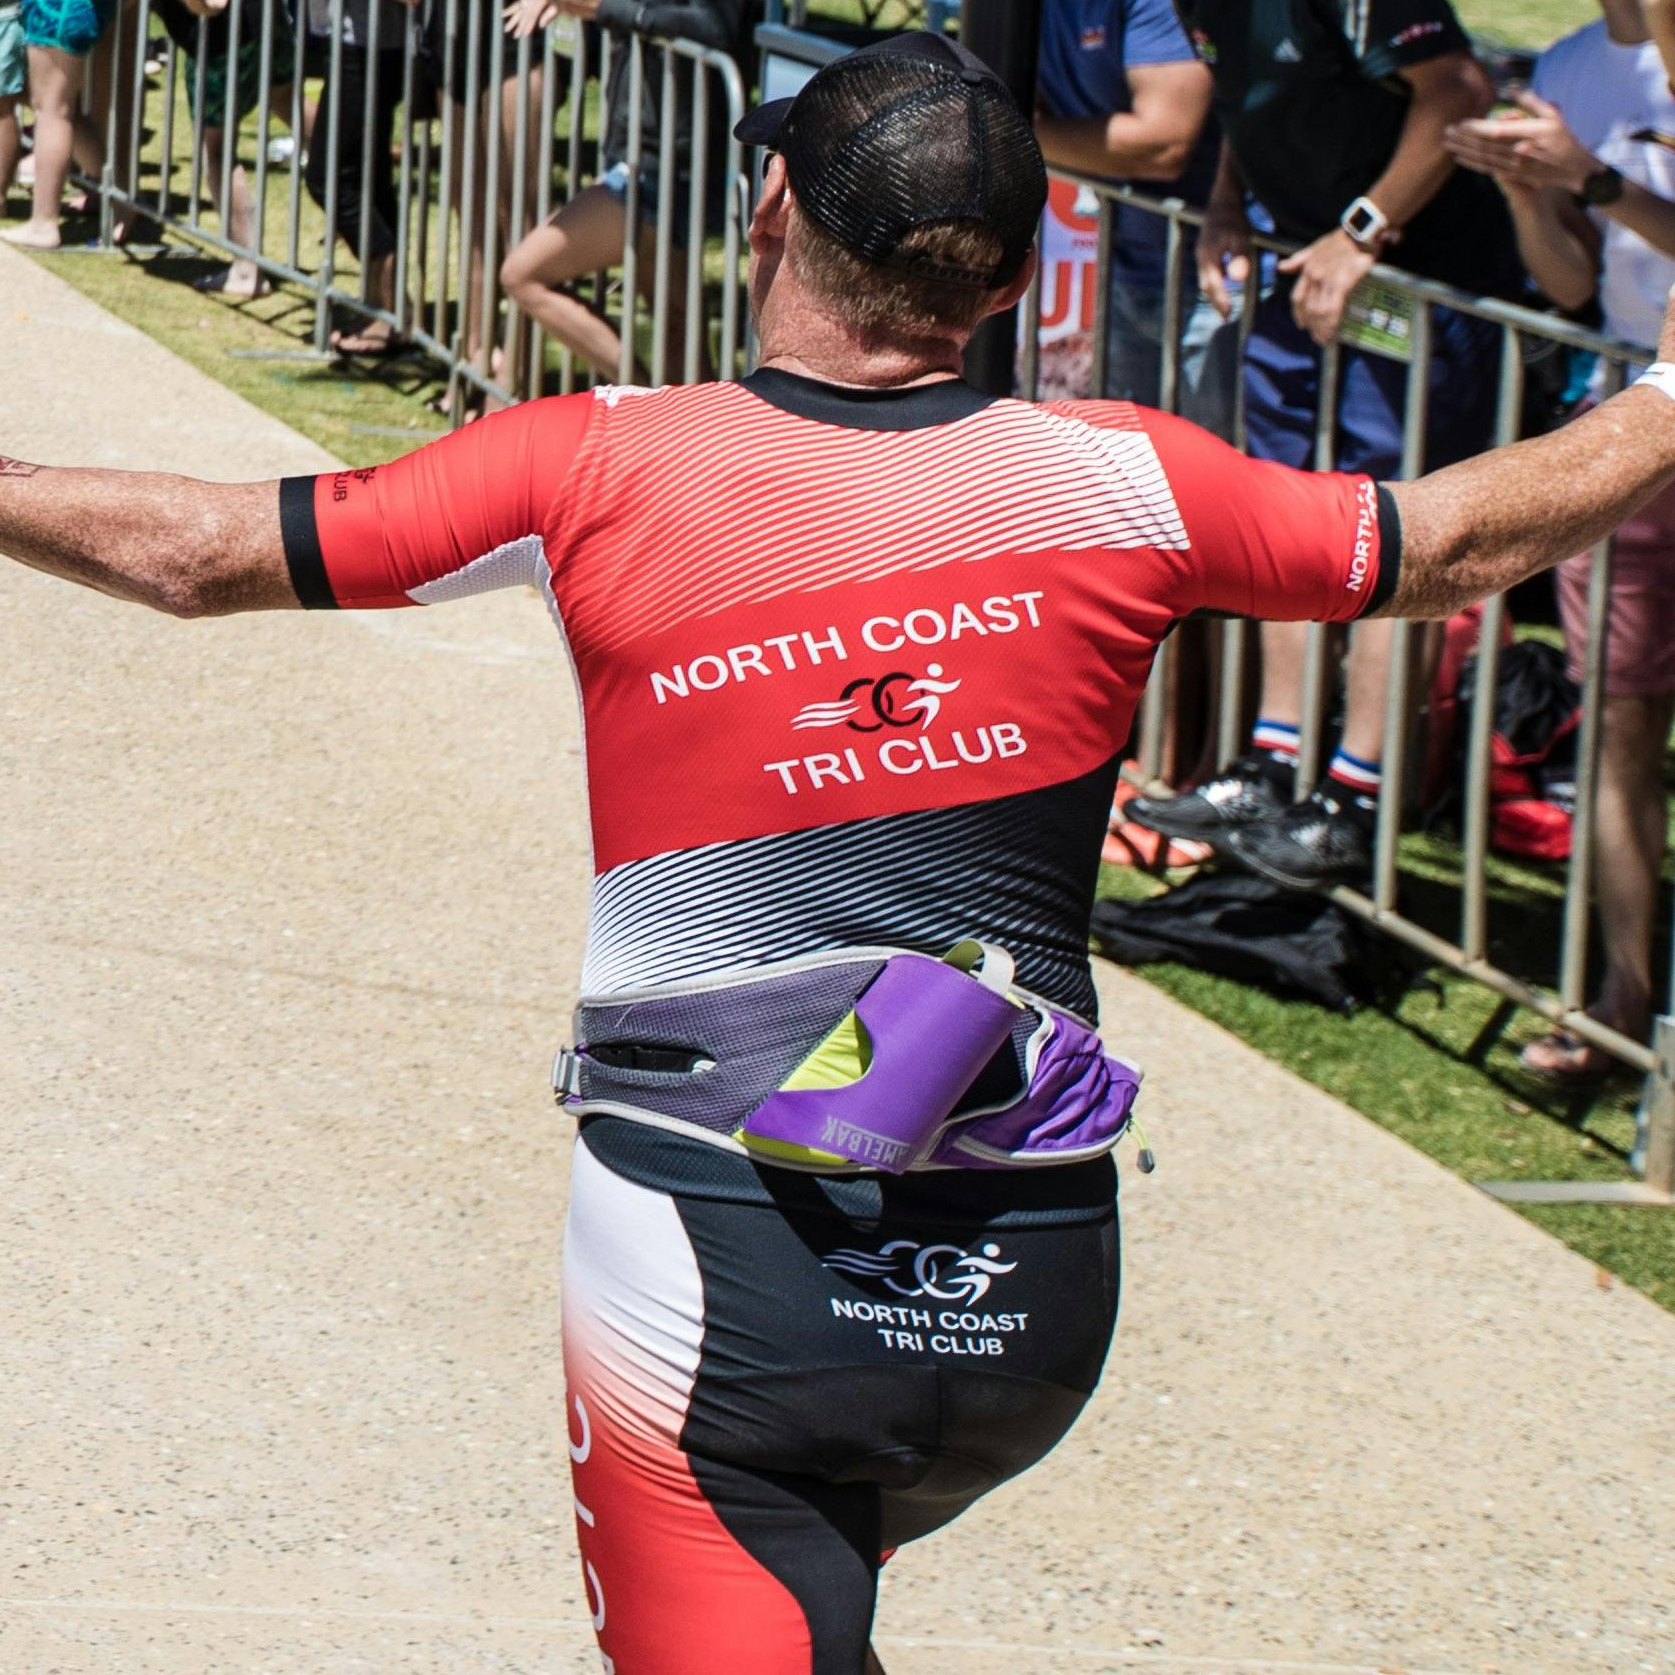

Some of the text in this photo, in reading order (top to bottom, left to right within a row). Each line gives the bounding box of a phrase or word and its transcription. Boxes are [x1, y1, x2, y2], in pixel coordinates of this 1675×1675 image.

[1345, 508, 1373, 592] NORTH
[649, 590, 1045, 706] NORTH COAST
[762, 721, 1029, 797] TRI CLUB
[829, 1297, 1029, 1332] NORTH COAST
[877, 1328, 1006, 1356] TRI CLUB
